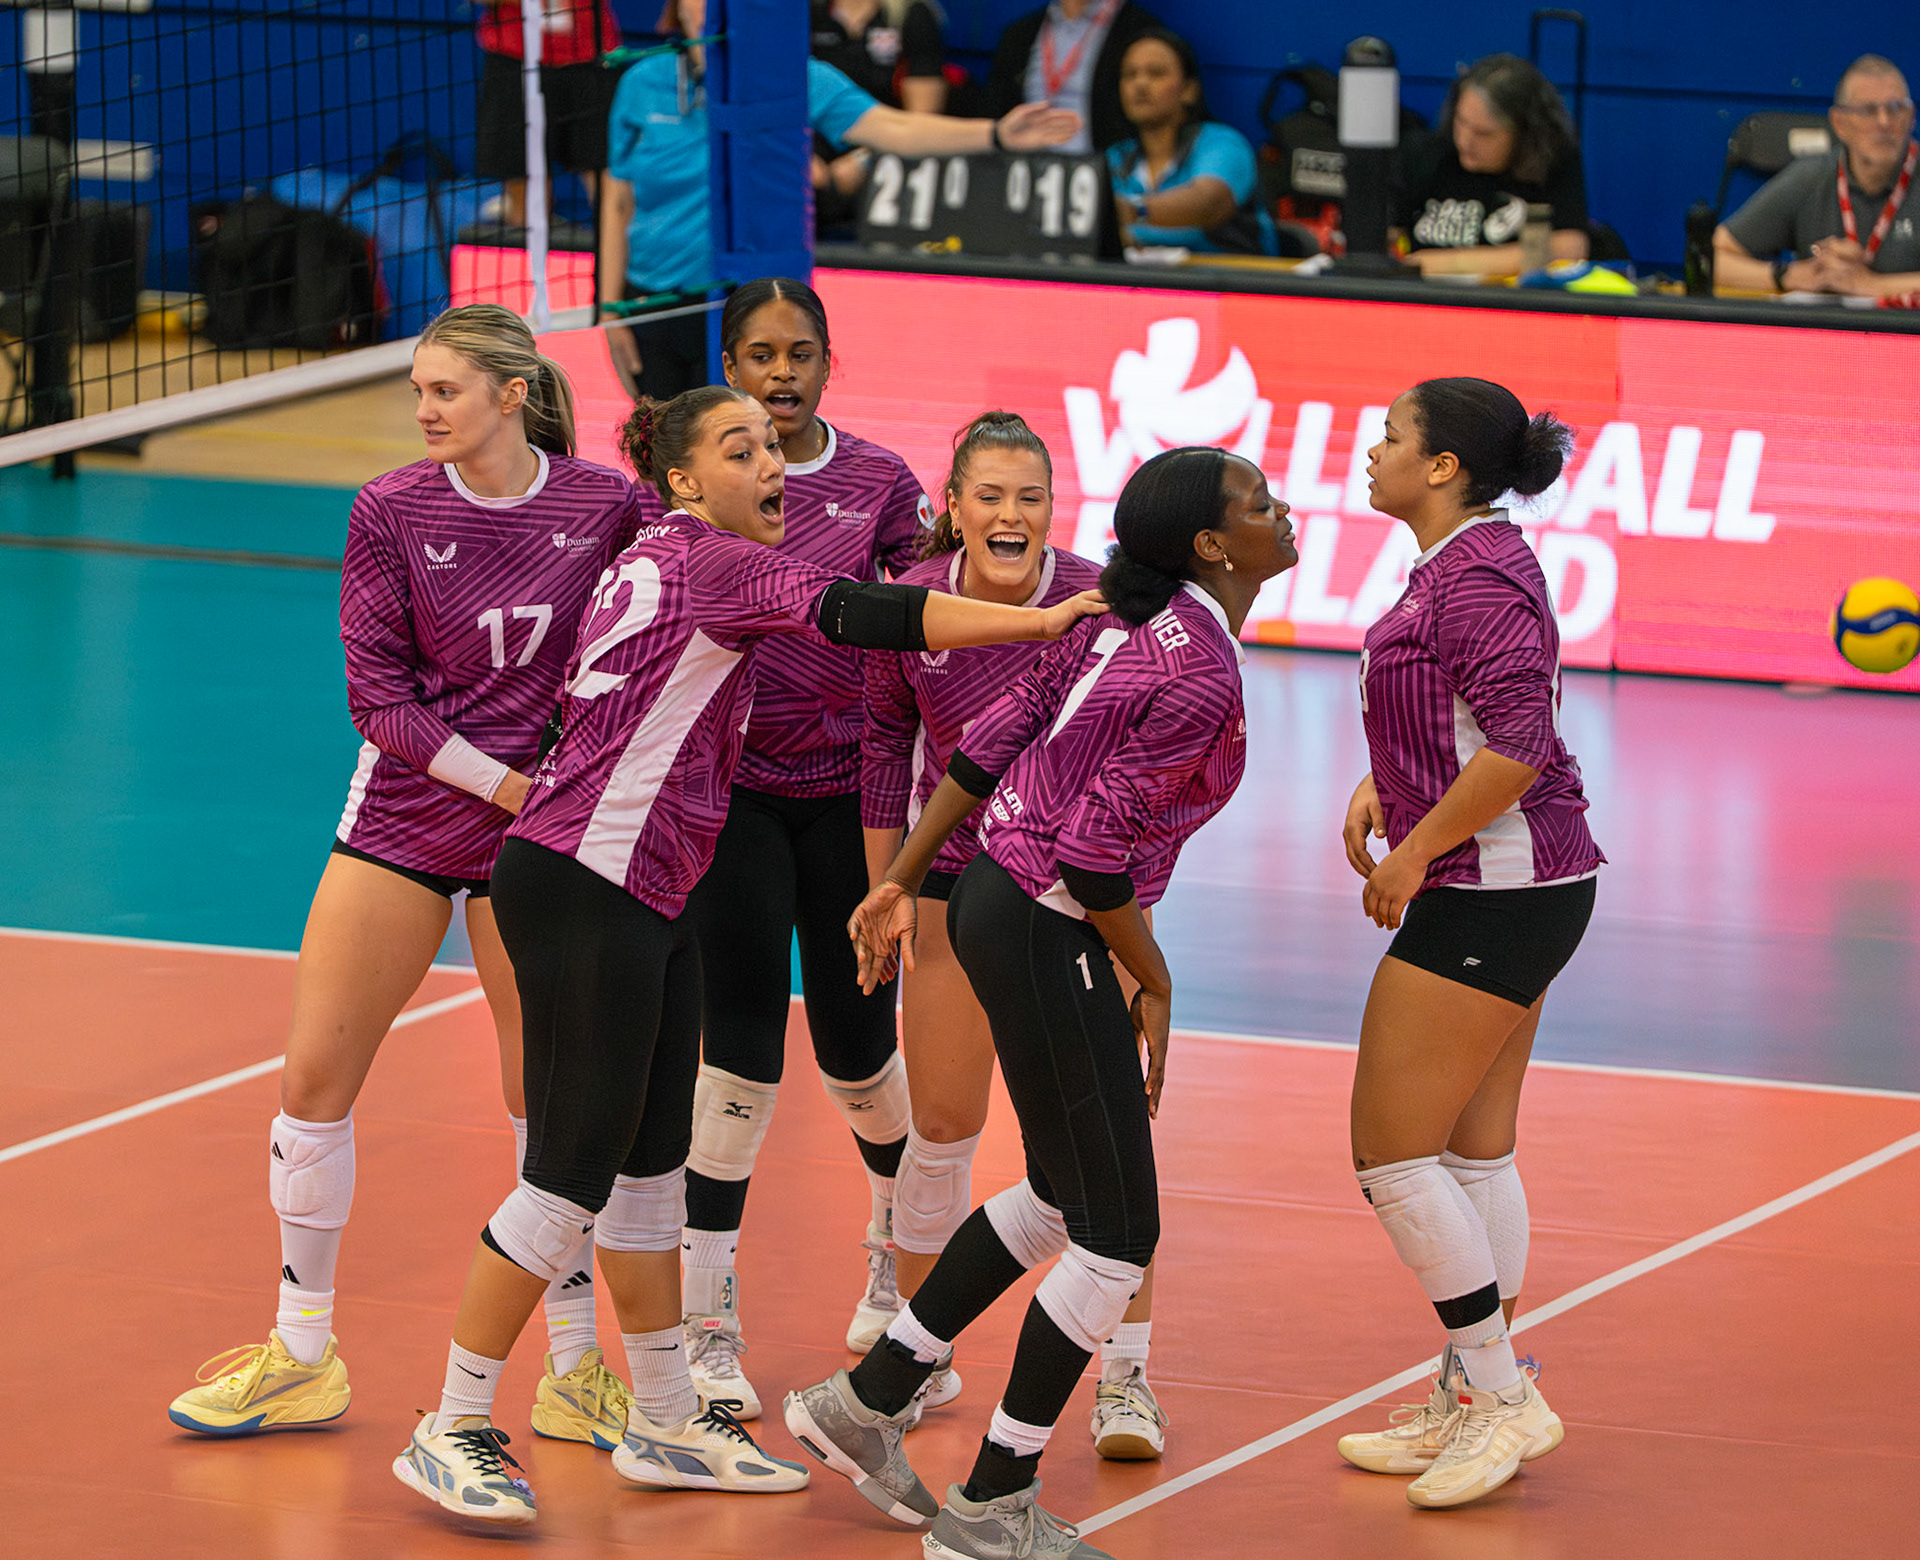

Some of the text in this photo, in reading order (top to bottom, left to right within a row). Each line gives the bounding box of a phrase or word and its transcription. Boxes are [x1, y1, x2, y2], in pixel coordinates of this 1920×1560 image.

[867, 154, 1098, 238] 21 0 0 19
[838, 510, 871, 519] Durham
[566, 536, 600, 547] Durham
[427, 563, 458, 571] CASTORE
[477, 604, 553, 668] 17
[1148, 605, 1191, 653] NER
[1002, 786, 1024, 816] LETS
[1075, 951, 1094, 990] 1
